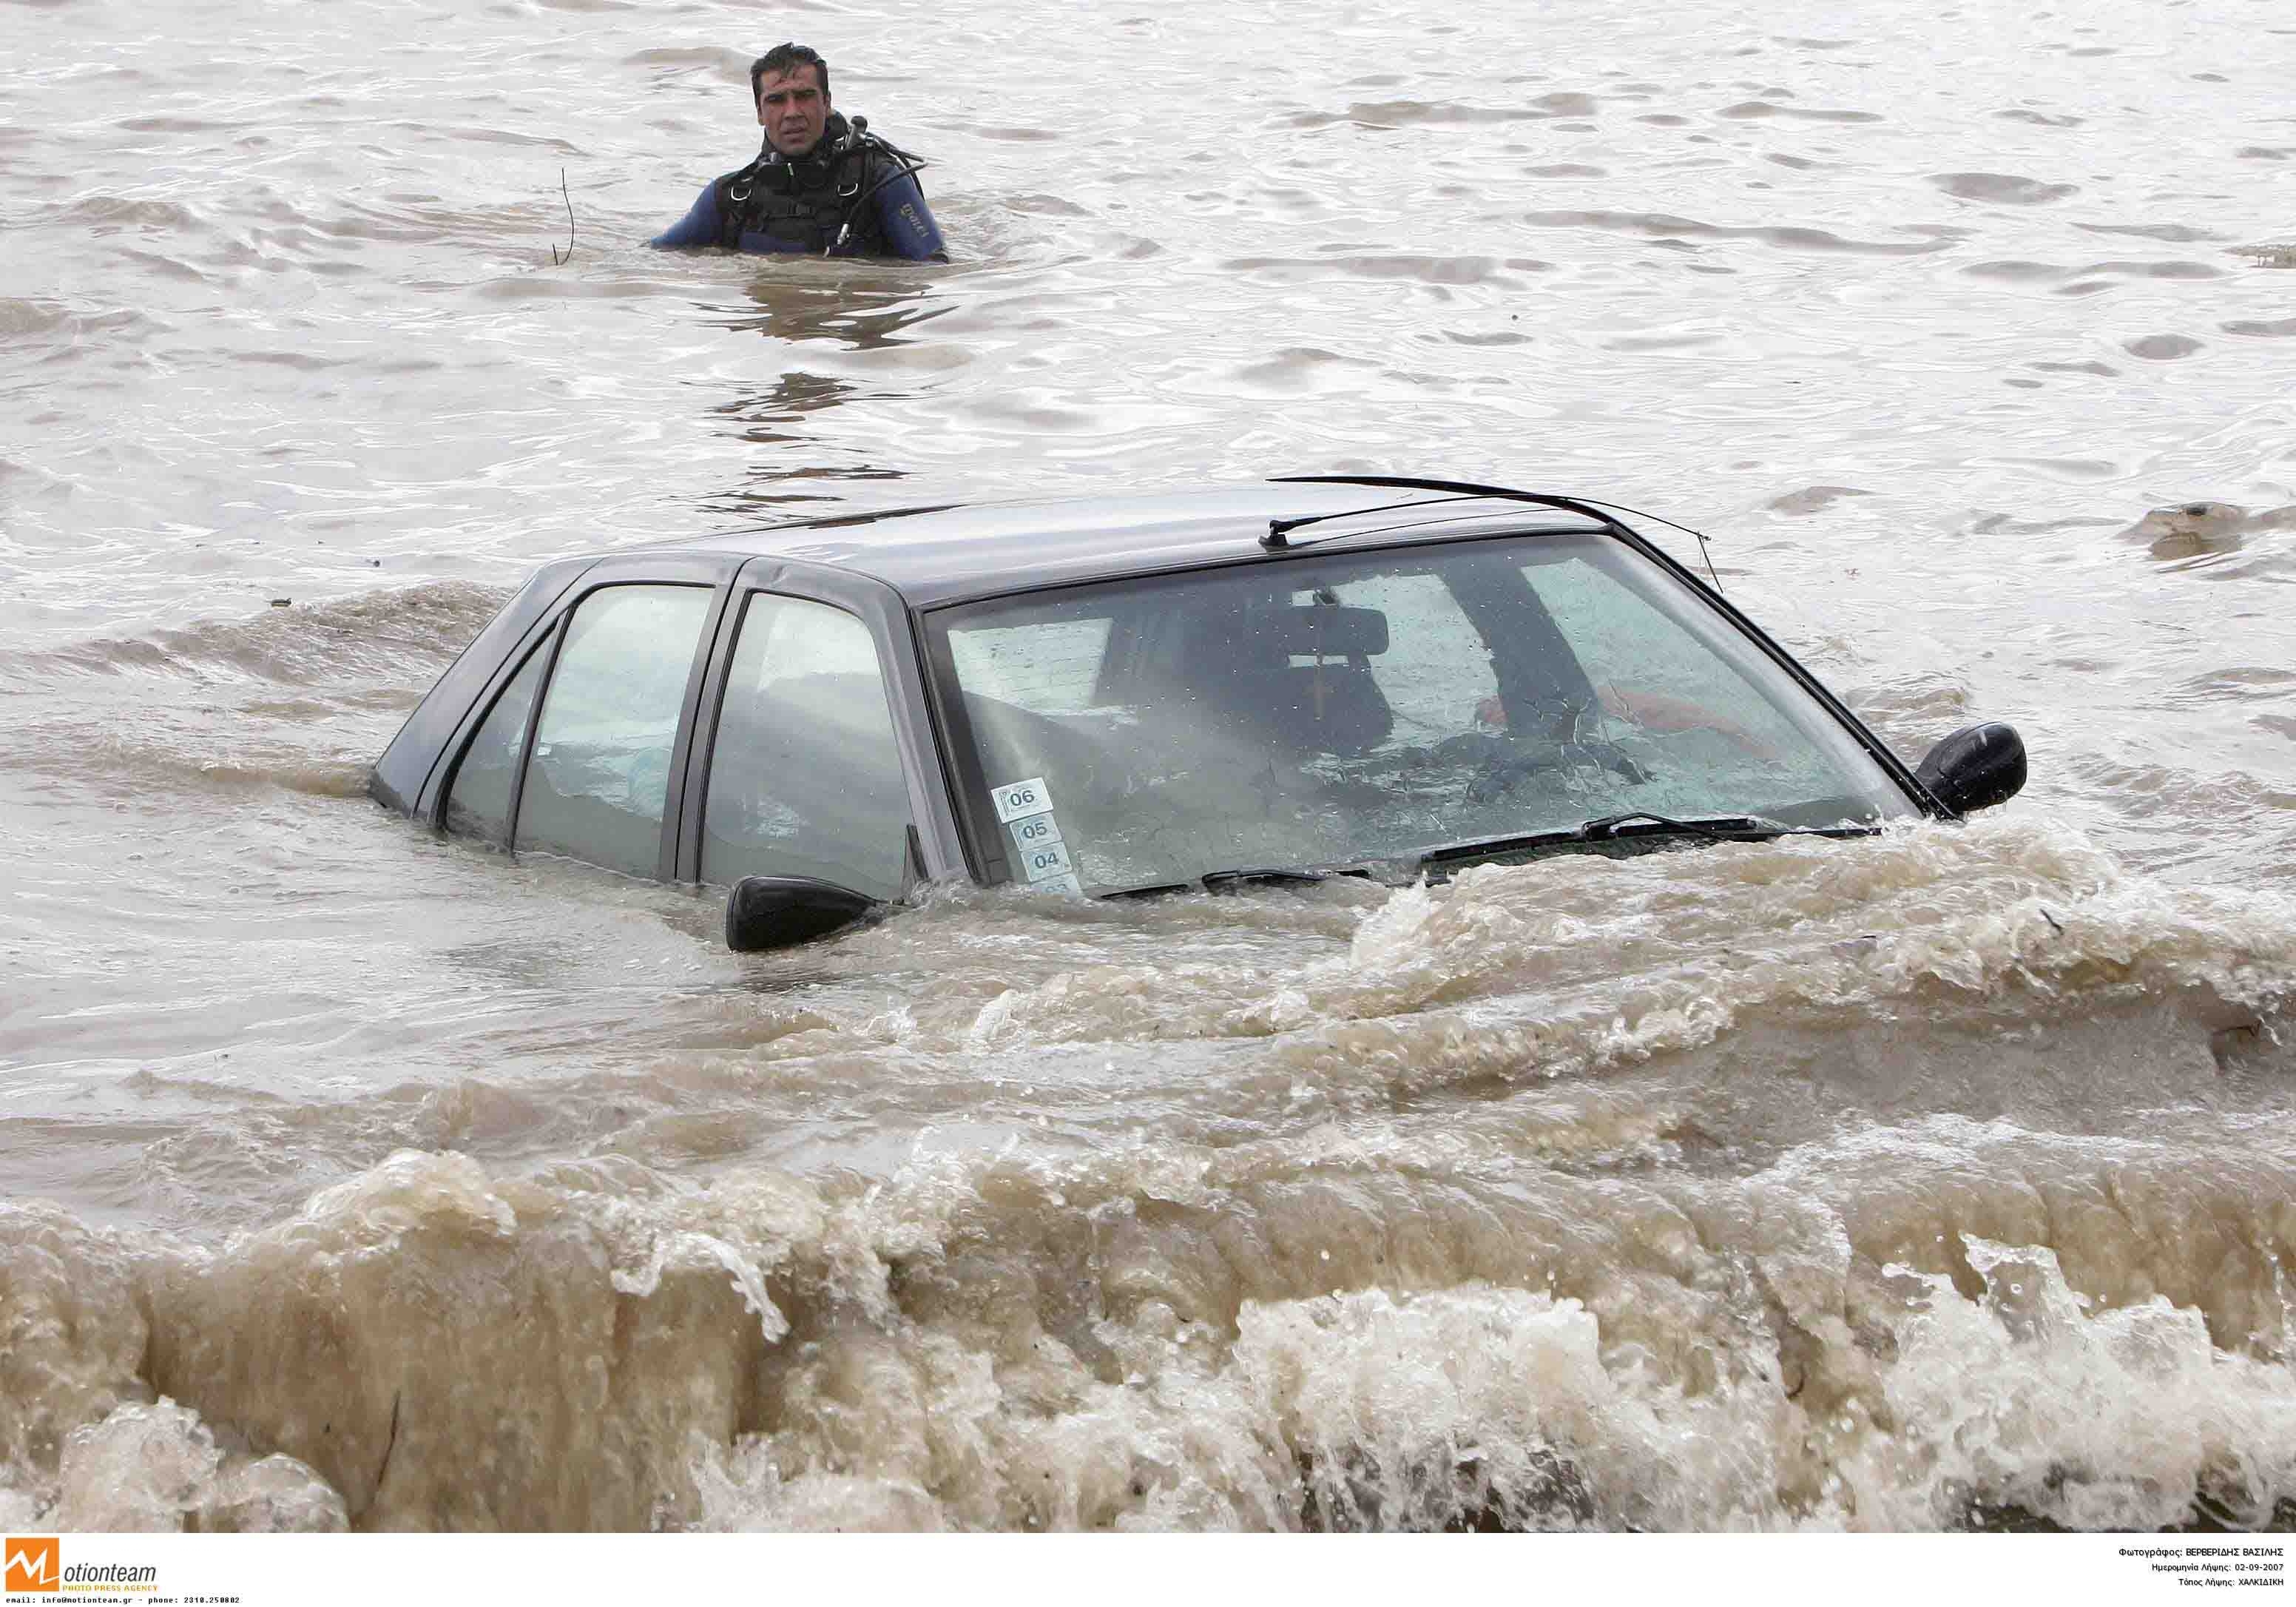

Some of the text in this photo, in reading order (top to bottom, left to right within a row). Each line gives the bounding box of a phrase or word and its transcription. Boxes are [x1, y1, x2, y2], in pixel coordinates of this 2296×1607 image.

[1010, 789, 1035, 806] 06
[1022, 821, 1047, 839] 05
[1034, 852, 1059, 869] 04
